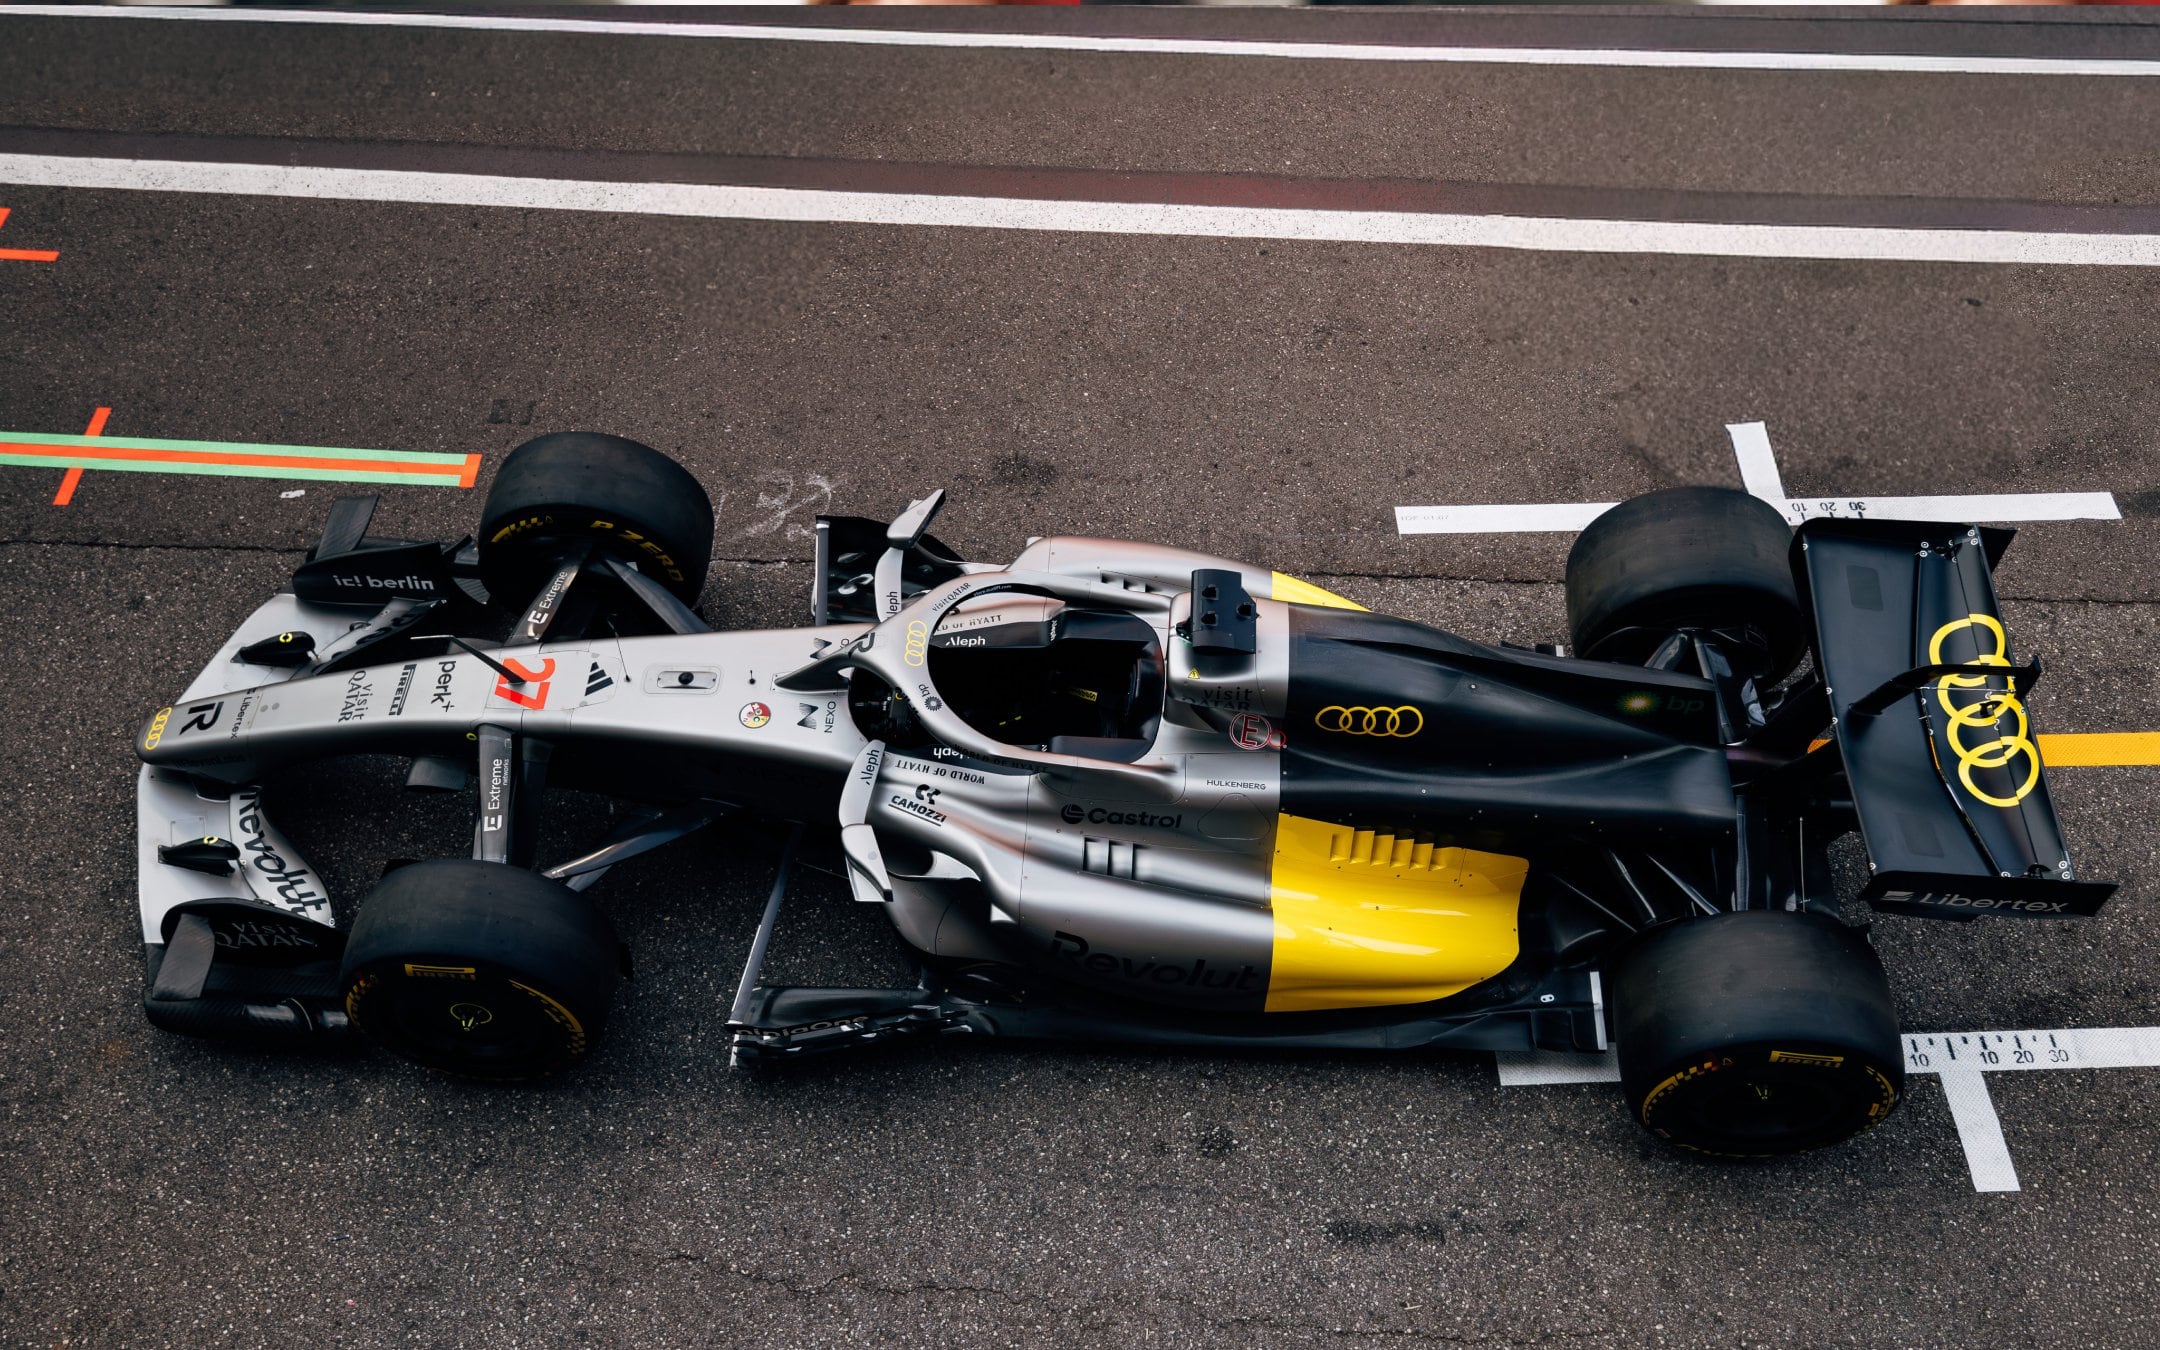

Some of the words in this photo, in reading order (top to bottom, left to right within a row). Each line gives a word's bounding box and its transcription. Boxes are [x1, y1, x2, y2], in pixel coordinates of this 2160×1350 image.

[1791, 502, 1807, 512] 10
[1819, 501, 1837, 511] 20
[1848, 501, 1866, 511] 30
[367, 575, 434, 590] berlin
[539, 571, 568, 610] Extreme
[886, 591, 900, 615] leph
[945, 636, 986, 648] Aleph
[389, 664, 418, 716] PIRELLI
[494, 657, 556, 710] 27
[918, 683, 931, 698] bp
[1203, 686, 1253, 701] visit
[338, 670, 367, 723] QATAR
[352, 683, 373, 720] visit
[1666, 696, 1705, 714] bp
[230, 696, 251, 740] Libertex
[823, 700, 837, 734] NEXO
[860, 749, 880, 786] Aleph
[895, 760, 930, 773] HYATT
[933, 767, 948, 777] OF
[487, 758, 502, 810] Extreme
[950, 772, 985, 785] WORLD
[891, 795, 947, 823] CAMOZZI
[1088, 807, 1182, 829] Castrol
[1918, 892, 2069, 914] Libertex
[1052, 930, 1258, 990] Revolut
[1909, 1054, 1929, 1067] 10
[1979, 1050, 2000, 1064] 10
[2013, 1050, 2035, 1064] 20
[2048, 1049, 2069, 1063] 30
